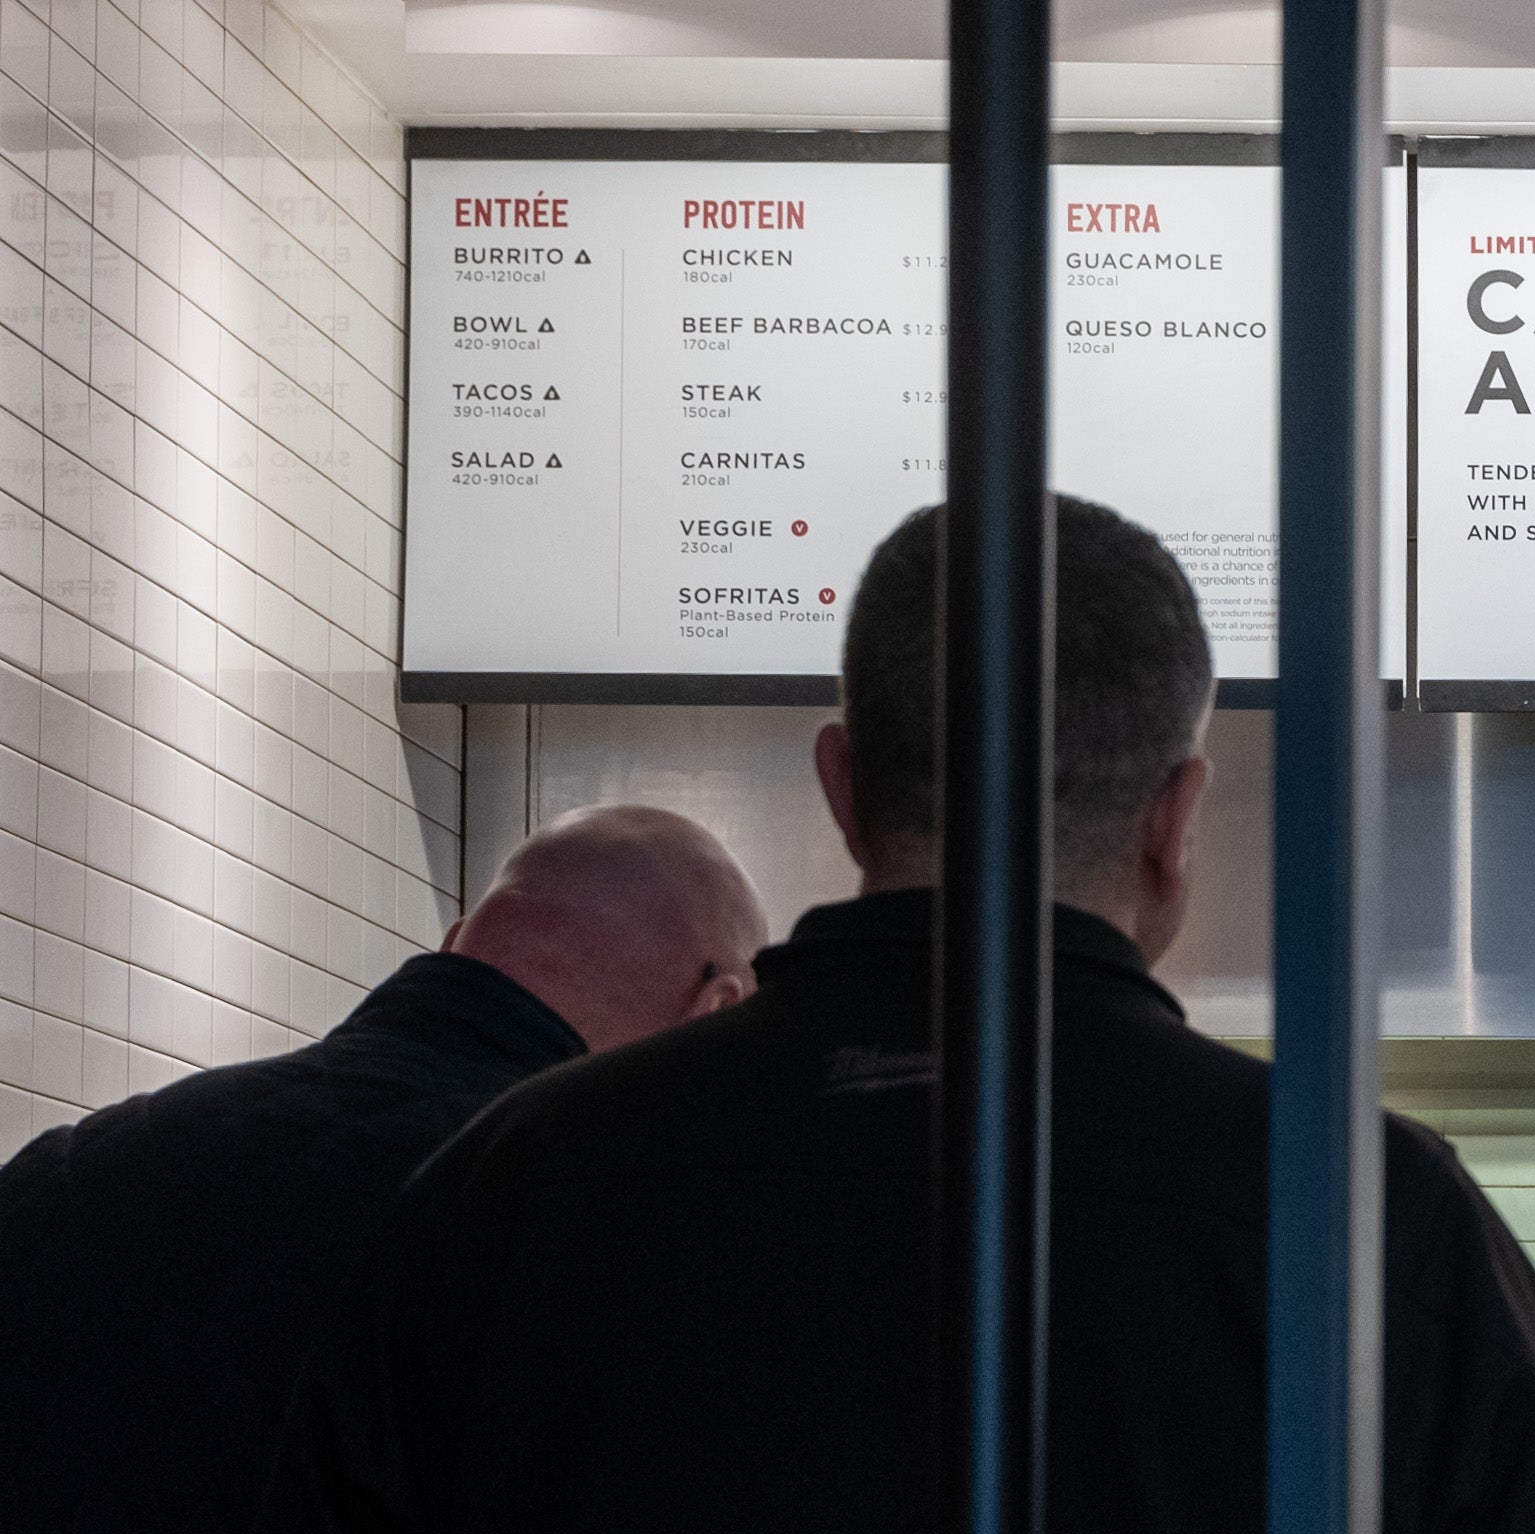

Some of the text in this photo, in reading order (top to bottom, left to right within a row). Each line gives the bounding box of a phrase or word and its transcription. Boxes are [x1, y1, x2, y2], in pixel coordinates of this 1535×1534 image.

[456, 191, 568, 227] ENTRÉE
[684, 200, 804, 229] PROTEIN
[1068, 203, 1160, 232] EXTRA
[455, 248, 563, 264] BURRITO
[683, 249, 792, 266] CHICKEN
[1066, 253, 1222, 270] GUACAMOLE
[456, 270, 545, 282] 740-1210cal
[684, 271, 732, 283] 180cal
[1067, 274, 1118, 286] 230cal
[454, 316, 527, 333] BOWL
[683, 317, 891, 334] BEEF BARBACOA
[1066, 320, 1266, 338] QUESO BLANCO
[454, 338, 540, 350] 420-910cal
[683, 339, 730, 350] 170cal
[1067, 342, 1114, 354] 120cal
[452, 384, 532, 401] TACOS
[682, 385, 761, 401] STEAK
[453, 406, 545, 418] 390-1140cal
[683, 406, 730, 418] 150cal
[452, 452, 534, 468] SALAD
[681, 452, 805, 469] CARNITAS
[452, 473, 538, 485] 420-910cal
[682, 474, 730, 486] 210cal
[1467, 495, 1526, 510] WITH
[680, 520, 772, 536] VEGGIE
[1467, 525, 1516, 540] AND
[1161, 531, 1254, 543] used for general
[681, 542, 732, 553] 230cal
[1223, 548, 1270, 557] nutrition
[1201, 561, 1209, 570] is
[1222, 561, 1264, 571] chance
[1192, 575, 1255, 586] ingredients
[1259, 577, 1268, 585] in
[679, 588, 799, 604] SOFRITAS
[680, 609, 834, 622] Plant-Based Protein
[680, 626, 728, 638] 150cal
